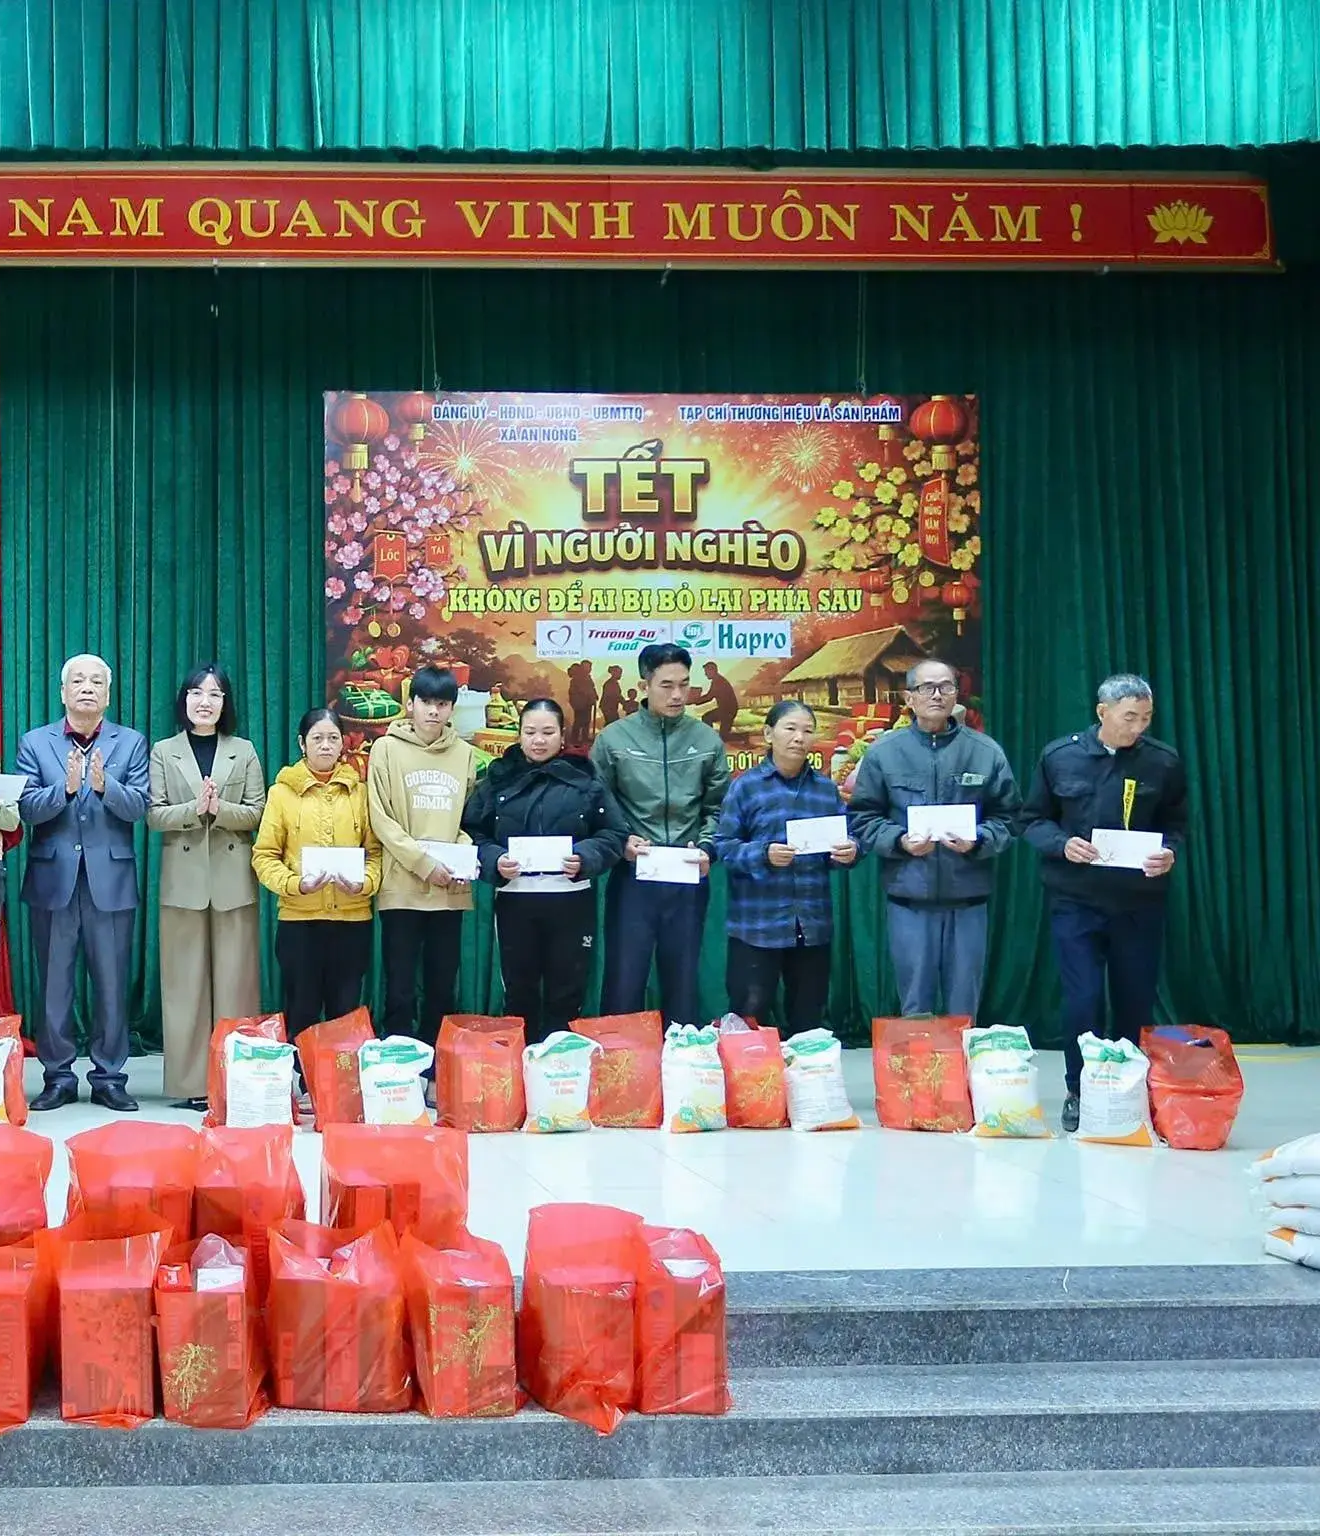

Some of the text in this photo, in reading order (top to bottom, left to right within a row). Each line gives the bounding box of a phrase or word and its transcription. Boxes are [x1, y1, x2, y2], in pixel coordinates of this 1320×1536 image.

[8, 197, 164, 237] NAM
[187, 197, 427, 247] QUANG
[455, 200, 636, 242] VINH
[663, 188, 860, 242] MUÔN
[889, 191, 1043, 243] NĂM
[1069, 202, 1084, 242] !
[679, 405, 703, 424] TẠP
[707, 403, 728, 421] CHÍ
[730, 405, 780, 421] THƯƠNG
[783, 403, 811, 424] HIỆU
[834, 402, 862, 421] SẢN
[863, 401, 901, 421] PHẨM
[572, 439, 707, 516] TẾT
[483, 521, 526, 572] VÌ
[666, 522, 801, 572] NGHÈO
[448, 580, 863, 617] KHÔNG ĐỂ AI BỊ BỎ LẠI PHÍA SAU
[607, 640, 639, 651] Food
[718, 623, 787, 655] Hapro
[737, 752, 753, 770] 01
[404, 769, 460, 793] GORGEOUS
